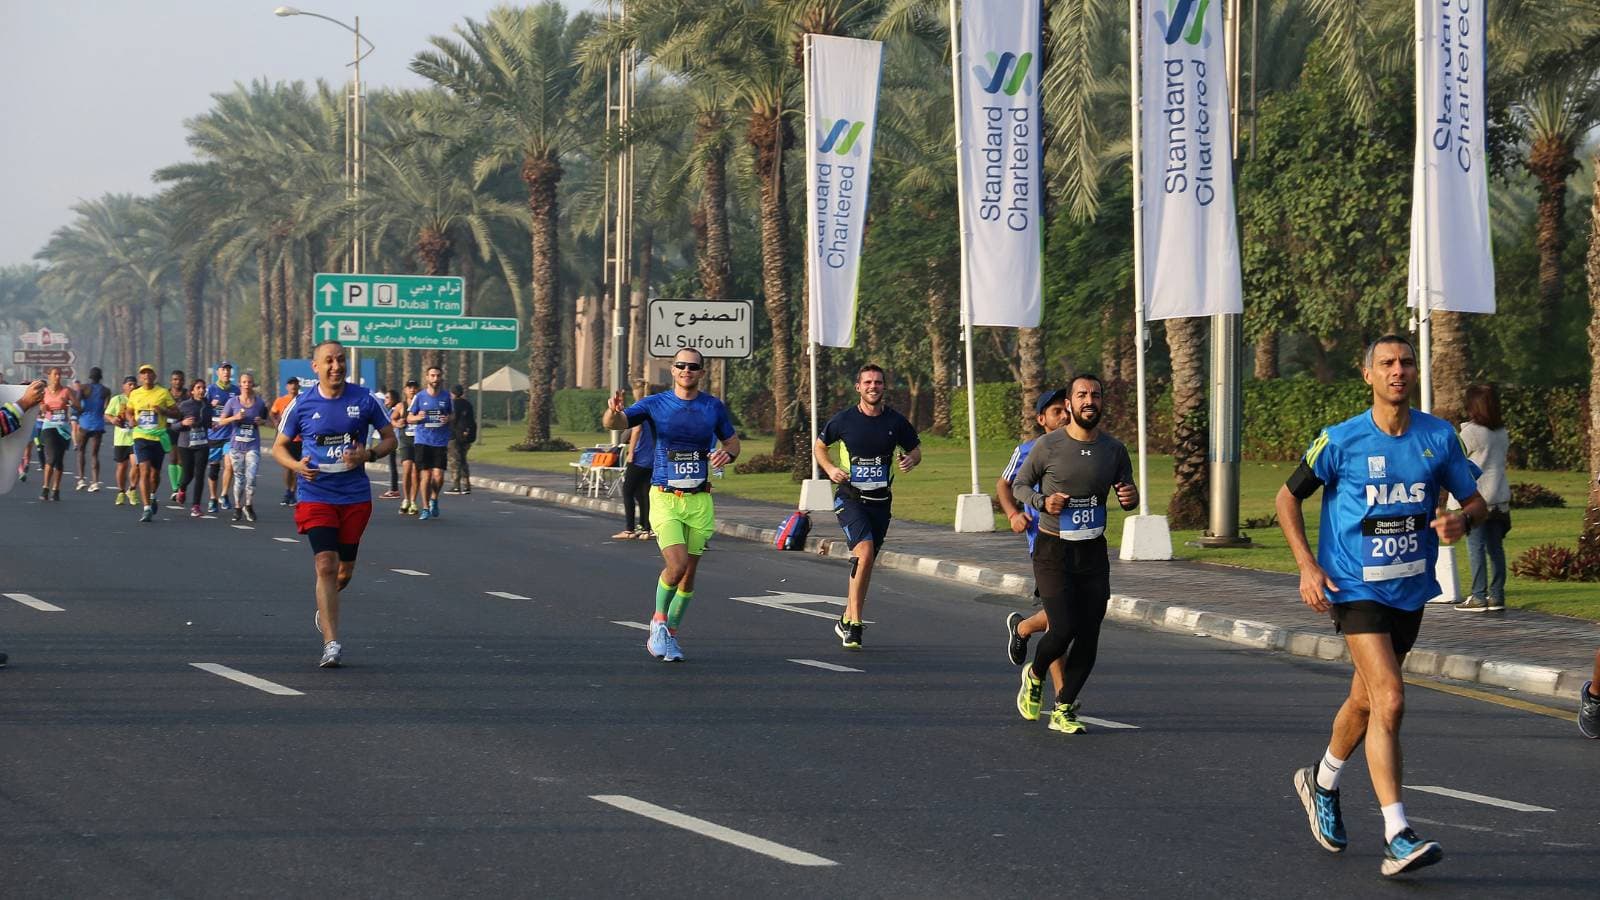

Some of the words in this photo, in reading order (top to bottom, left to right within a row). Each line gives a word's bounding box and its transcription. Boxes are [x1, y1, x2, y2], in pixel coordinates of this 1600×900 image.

[1163, 59, 1187, 194] Standard
[980, 106, 1003, 221] Standard
[1007, 107, 1029, 232] Chartered
[827, 165, 855, 269] Chartered
[348, 285, 362, 304] P
[409, 284, 433, 297] دبي
[438, 281, 461, 297] ترام
[398, 299, 429, 310] Dubai
[433, 300, 460, 311] Tram
[404, 318, 433, 331] للنقل
[674, 307, 745, 328] الصفوح
[364, 318, 402, 333] البحري
[436, 320, 478, 333] الصفوح
[480, 320, 516, 332] محطة
[359, 334, 371, 344] Al
[374, 335, 406, 344] Sufouh
[408, 336, 439, 345] Marine
[441, 336, 459, 346] Stn
[654, 334, 672, 348] Al
[676, 334, 734, 350] Sufouh
[736, 335, 745, 349] 1
[674, 462, 700, 475] 1653
[855, 466, 883, 478] 2256
[1366, 482, 1427, 507] NAS
[1072, 508, 1095, 525] 681
[1376, 519, 1405, 529] Standard
[1374, 527, 1405, 536] Chartered
[1371, 533, 1418, 558] 2095
